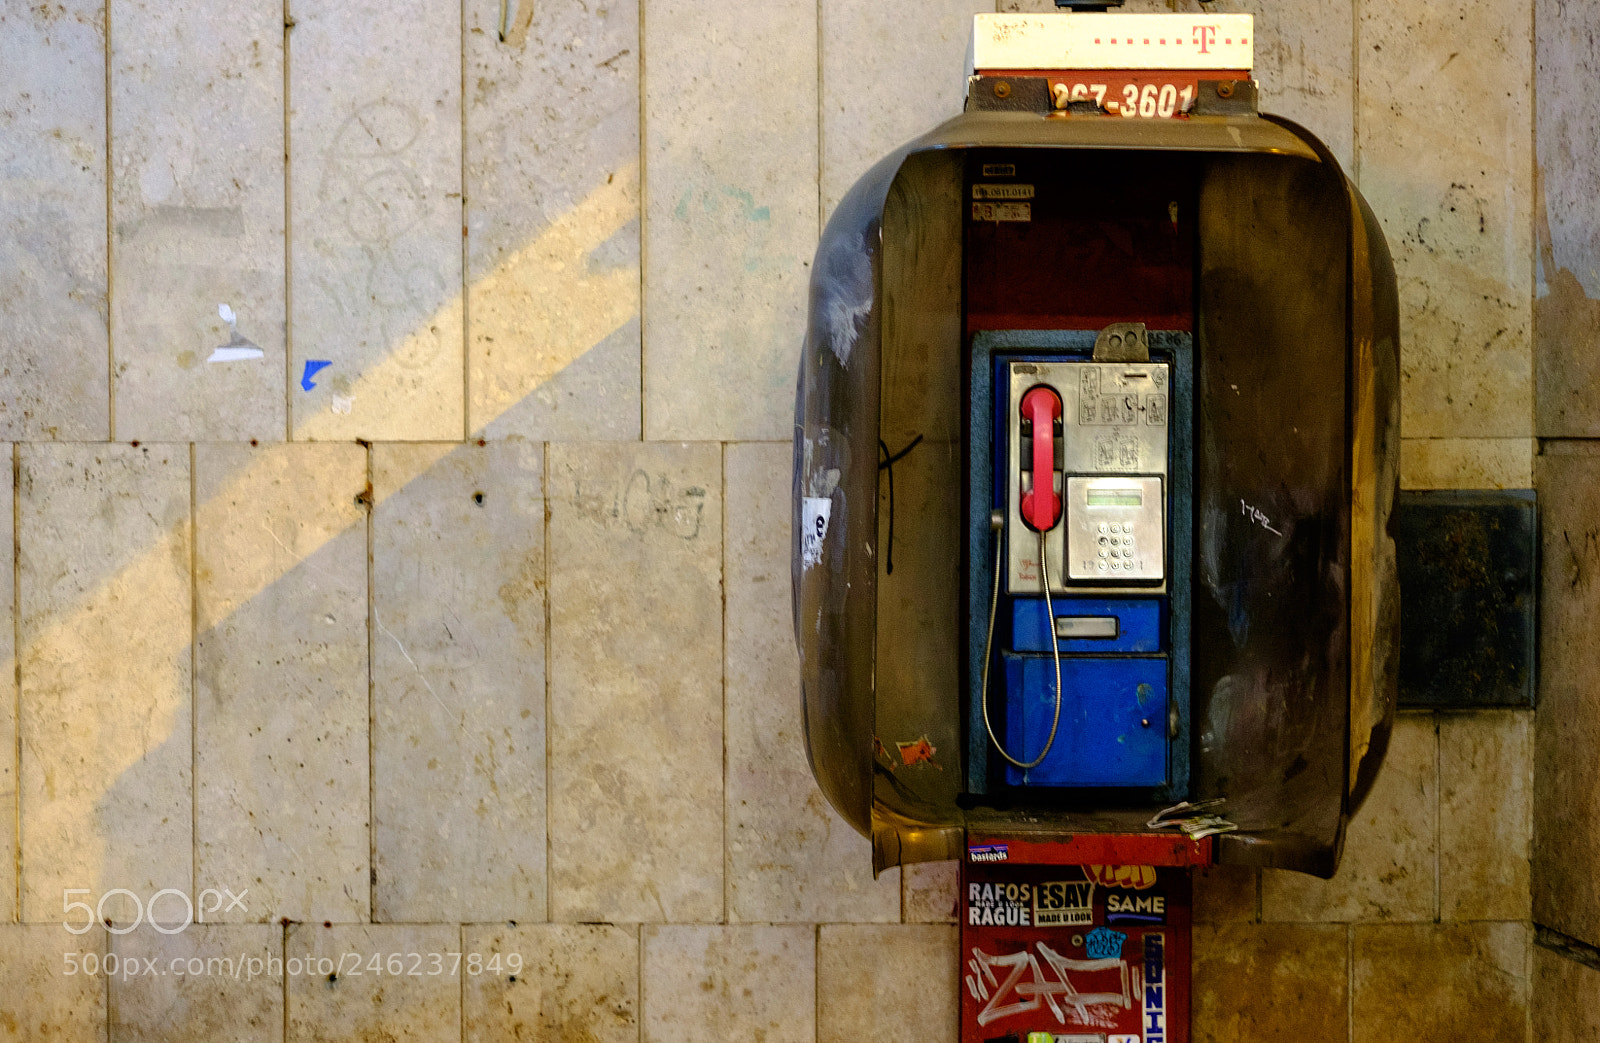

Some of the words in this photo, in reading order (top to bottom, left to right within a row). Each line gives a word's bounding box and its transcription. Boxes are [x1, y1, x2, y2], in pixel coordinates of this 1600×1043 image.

[1193, 26, 1216, 54] T
[969, 882, 1031, 902] RAFOS
[1037, 884, 1092, 909] ESAY
[1107, 894, 1165, 914] SAME
[969, 907, 1031, 927] RAGUE
[1039, 913, 1061, 923] MADE
[1071, 912, 1092, 922] LOOK
